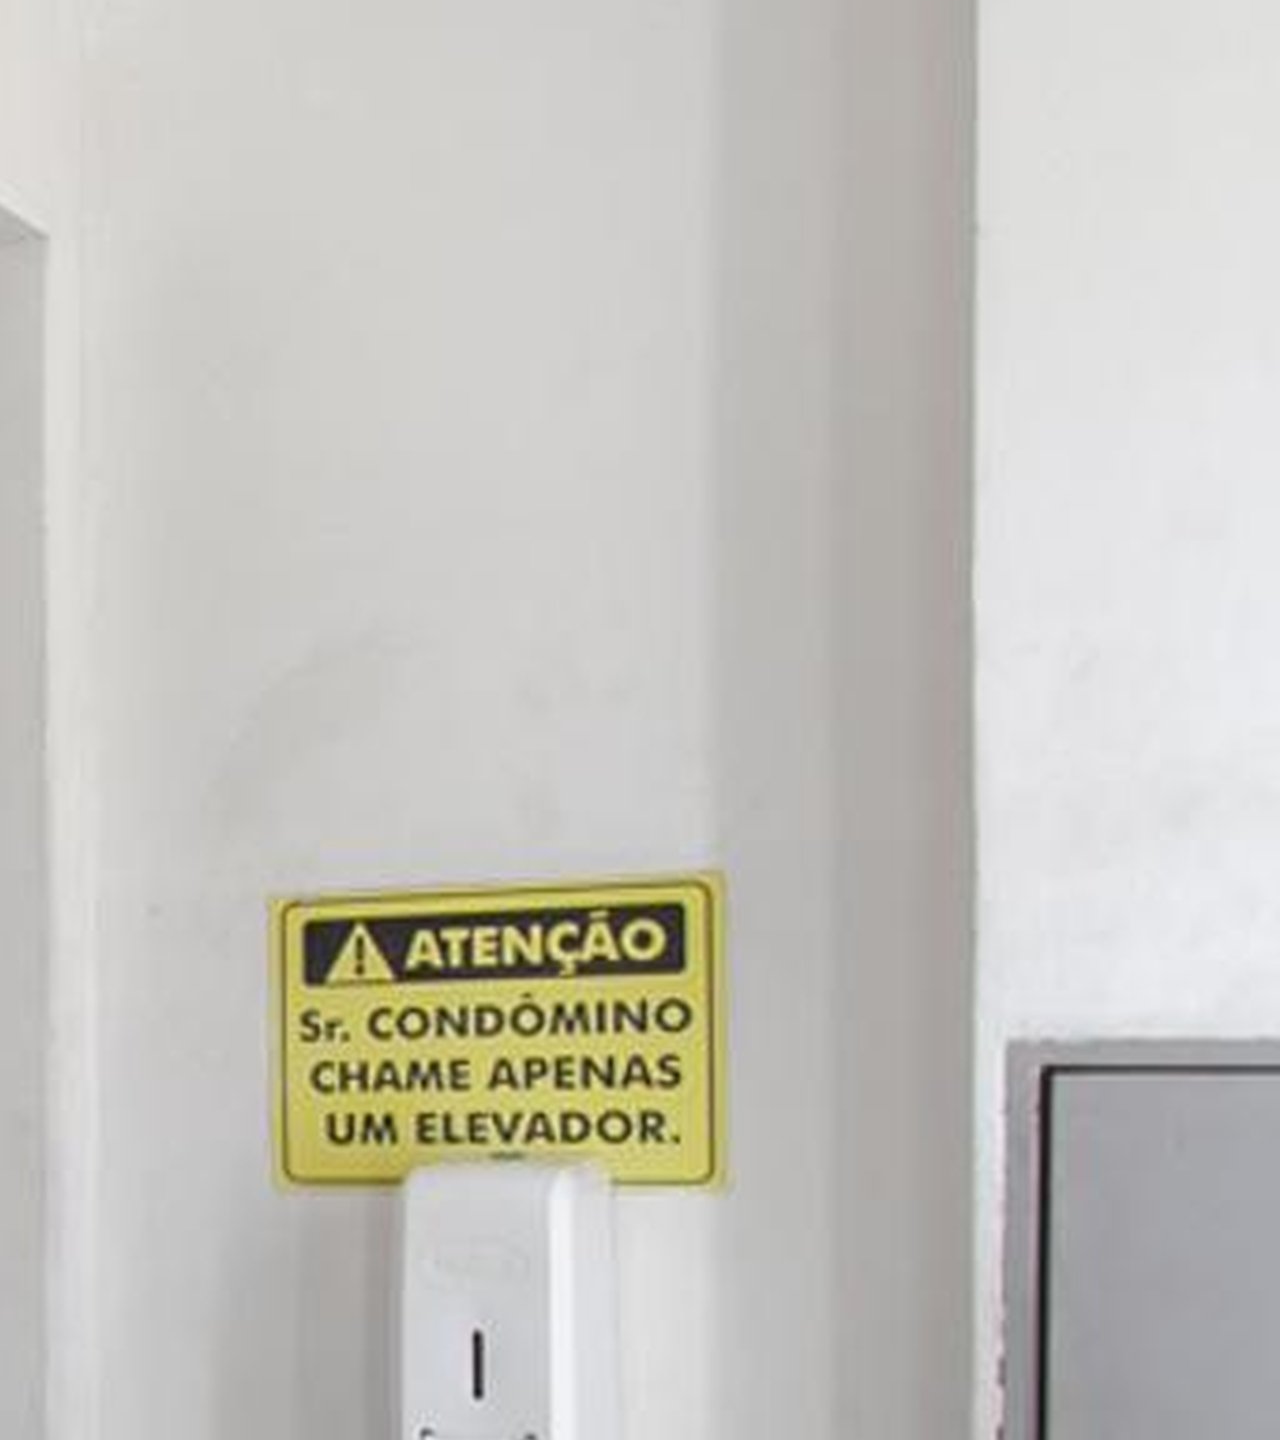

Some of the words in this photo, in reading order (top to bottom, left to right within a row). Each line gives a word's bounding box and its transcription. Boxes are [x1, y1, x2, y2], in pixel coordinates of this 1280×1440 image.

[405, 911, 668, 978] ATENÇÃO
[298, 1008, 352, 1043] Sr.
[367, 992, 694, 1042] CONDÔMINO
[309, 1059, 471, 1094] CHAME
[487, 1054, 683, 1091] APENAS
[325, 1113, 399, 1146] UM
[415, 1109, 683, 1146] ELEVADOR.
